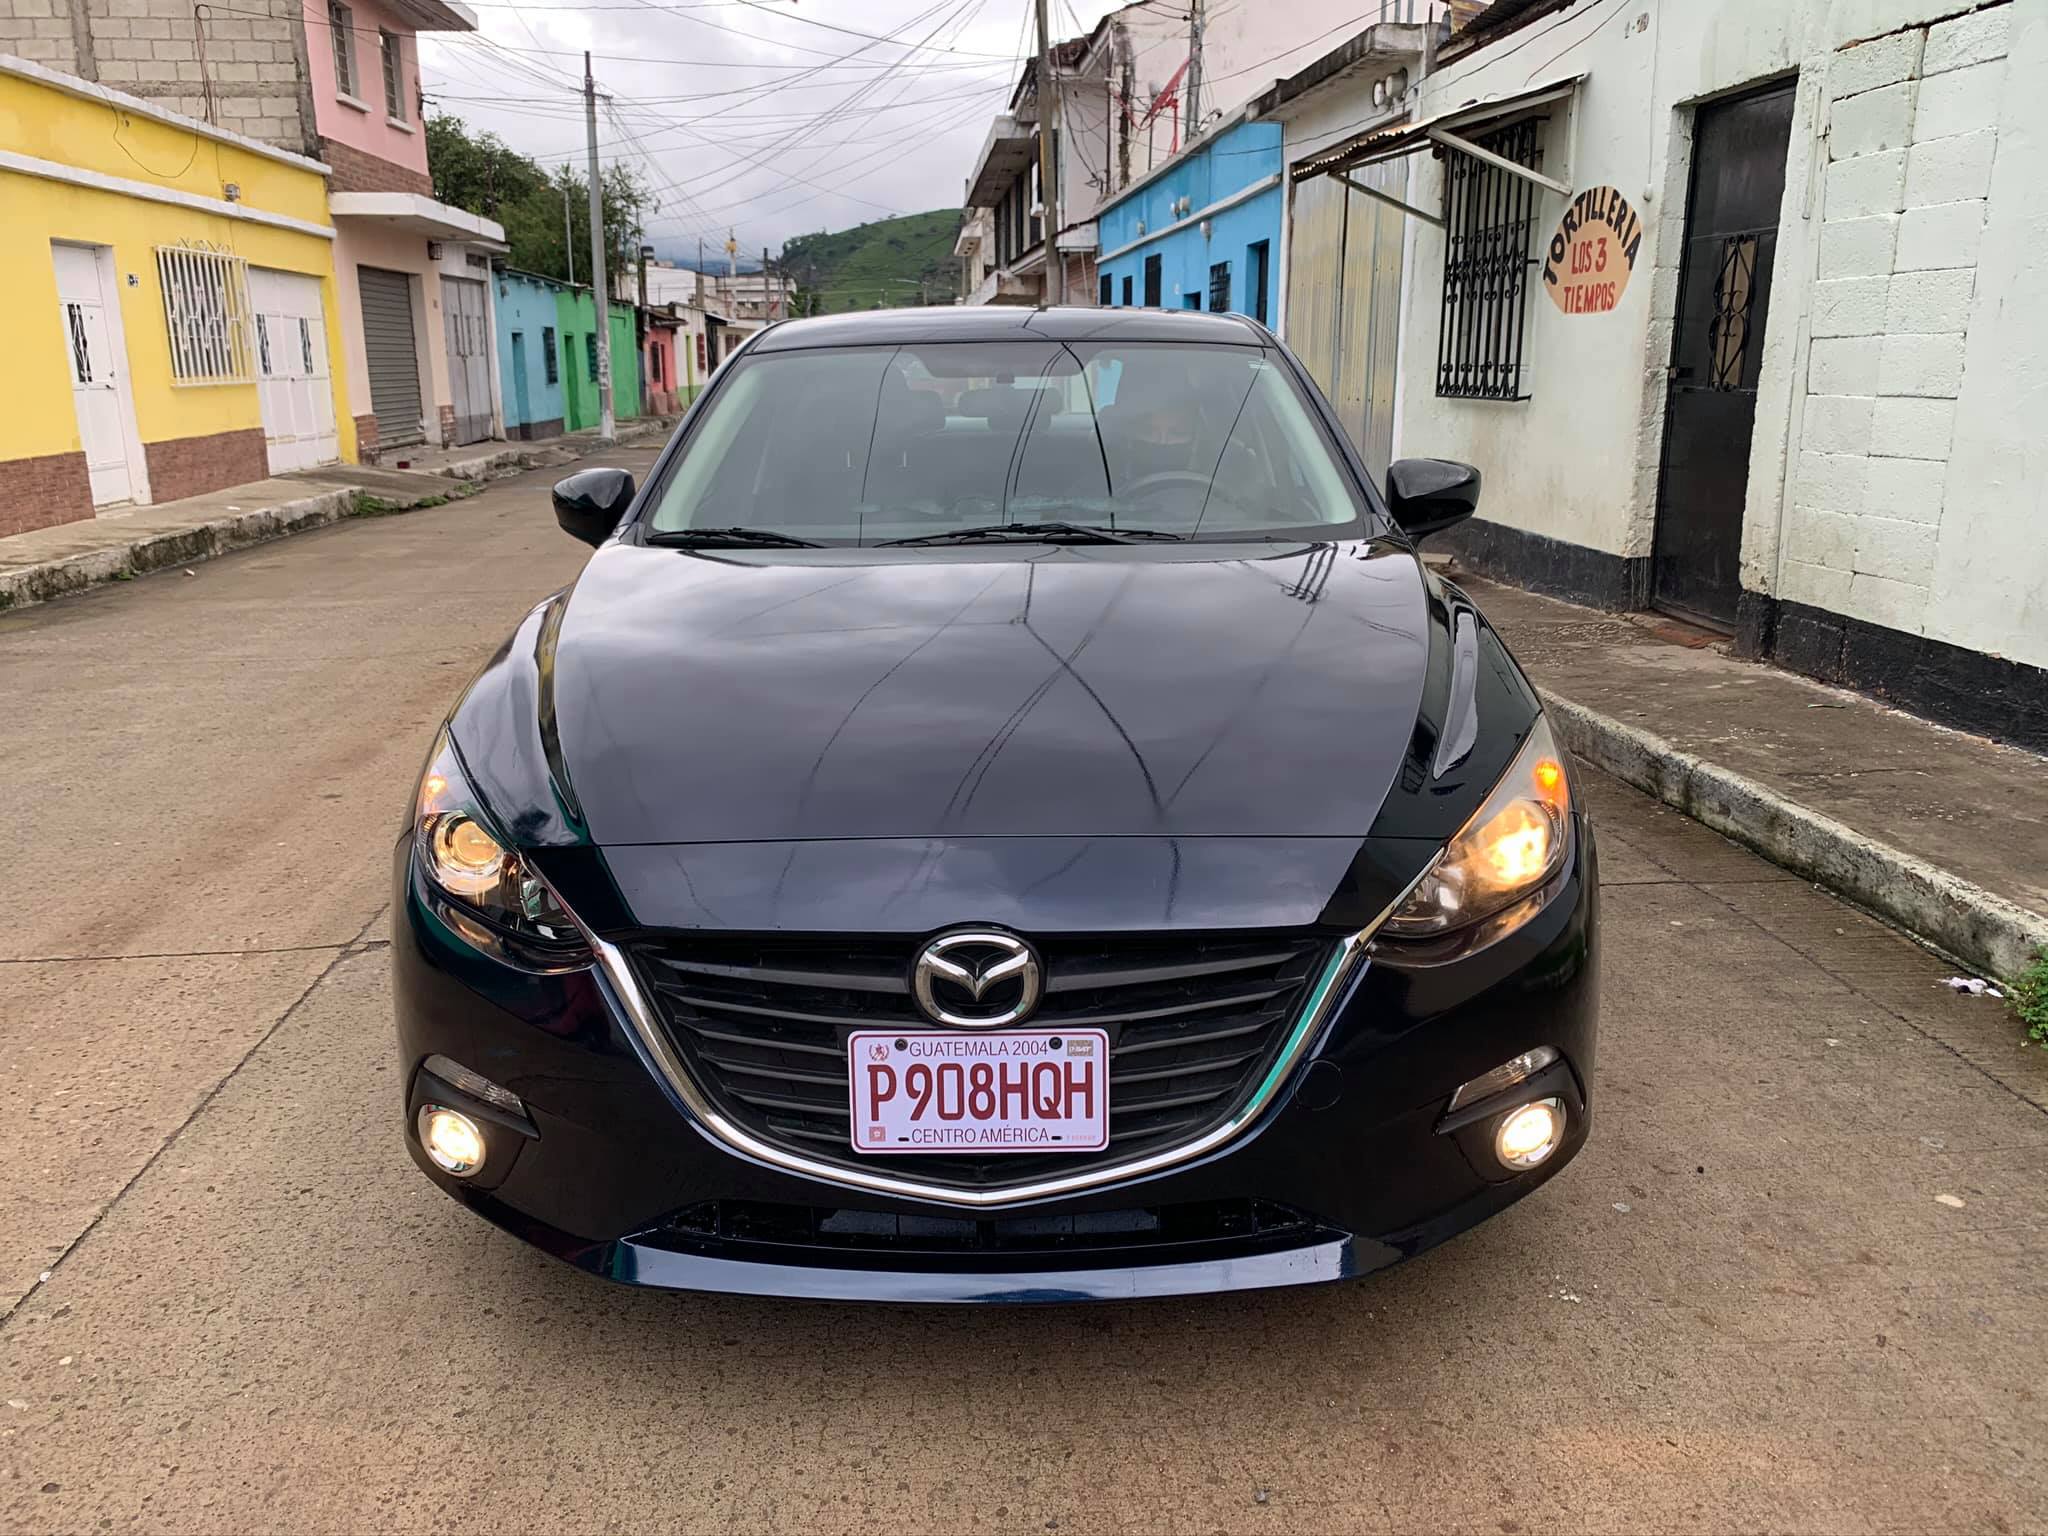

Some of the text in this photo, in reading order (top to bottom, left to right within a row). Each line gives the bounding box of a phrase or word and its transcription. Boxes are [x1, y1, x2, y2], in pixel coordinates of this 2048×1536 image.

[1543, 186, 1642, 286] TORTILLERIA
[1571, 237, 1607, 275] LOS 3
[1564, 282, 1616, 314] TIEMPOS
[909, 1041, 1009, 1057] GUATEMALA
[1012, 1040, 1048, 1056] 2004
[911, 1124, 1050, 1144] CENTRO AMÉRICA
